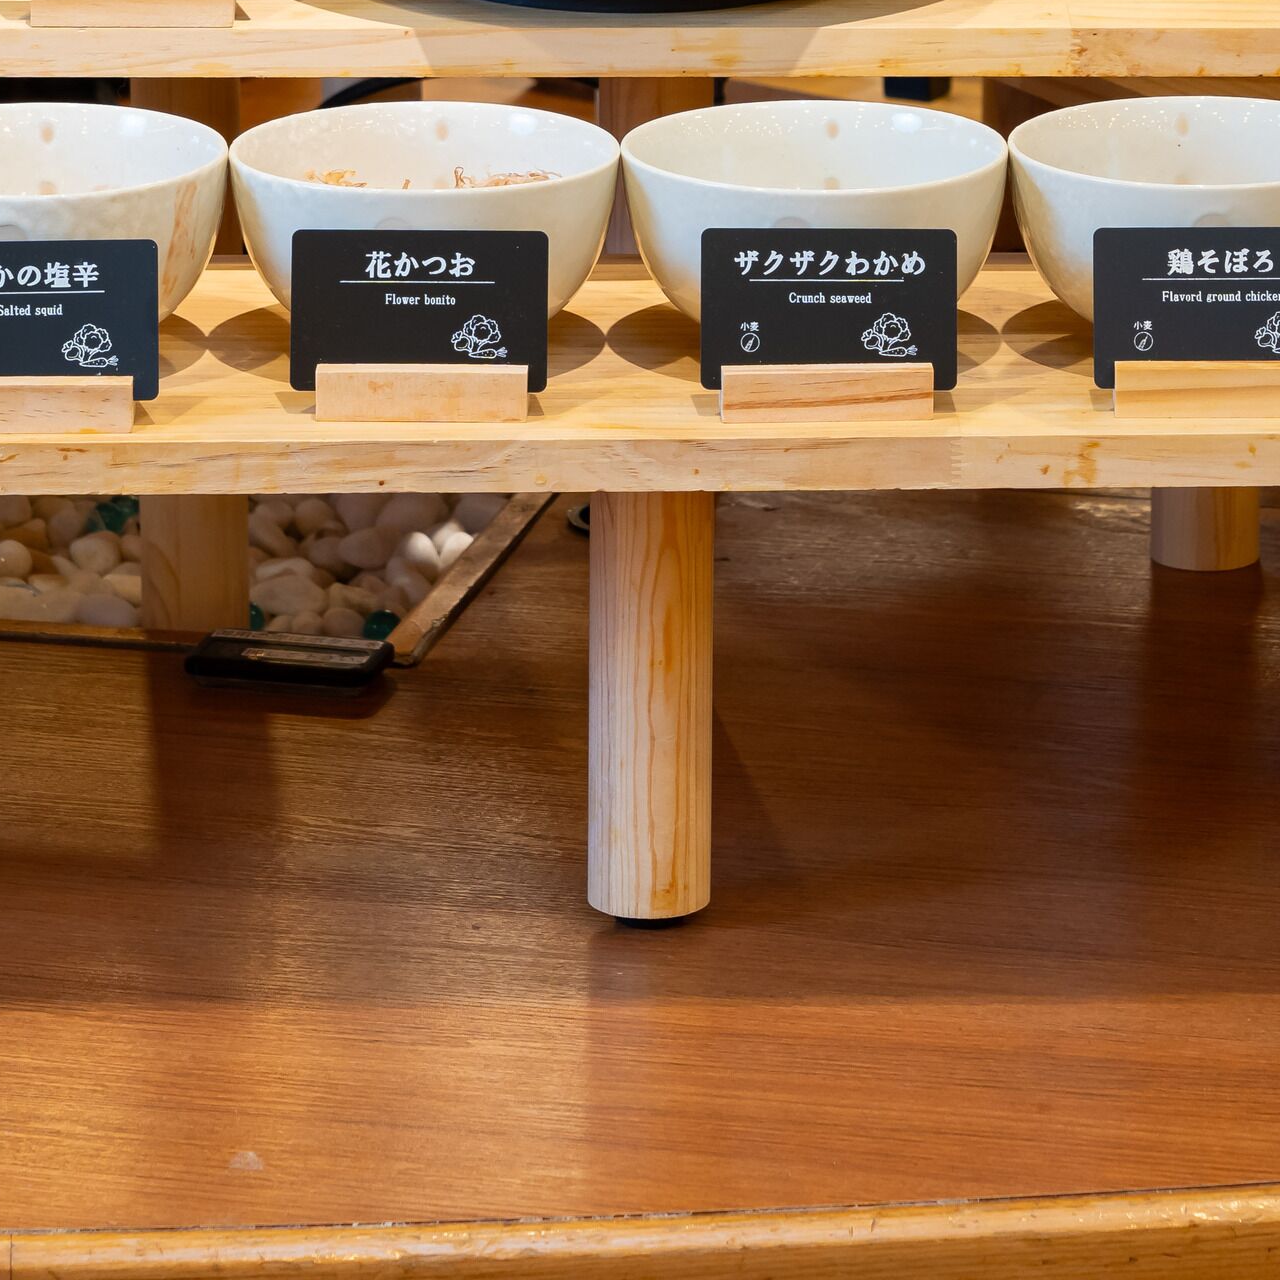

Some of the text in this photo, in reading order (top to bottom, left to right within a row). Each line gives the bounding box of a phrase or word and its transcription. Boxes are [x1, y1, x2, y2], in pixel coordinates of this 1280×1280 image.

[364, 250, 476, 279] 花かつお
[733, 250, 926, 279] ザクザクわかめ
[1167, 247, 1274, 276] 鶏そぼろ
[385, 293, 456, 306] Flower bonito
[788, 291, 872, 304] Crunch seaweed
[1162, 290, 1203, 303] Flavord
[1206, 290, 1242, 303] ground
[34, 303, 63, 317] squid
[740, 321, 760, 332] 小麦
[1133, 320, 1153, 331] 小麦
